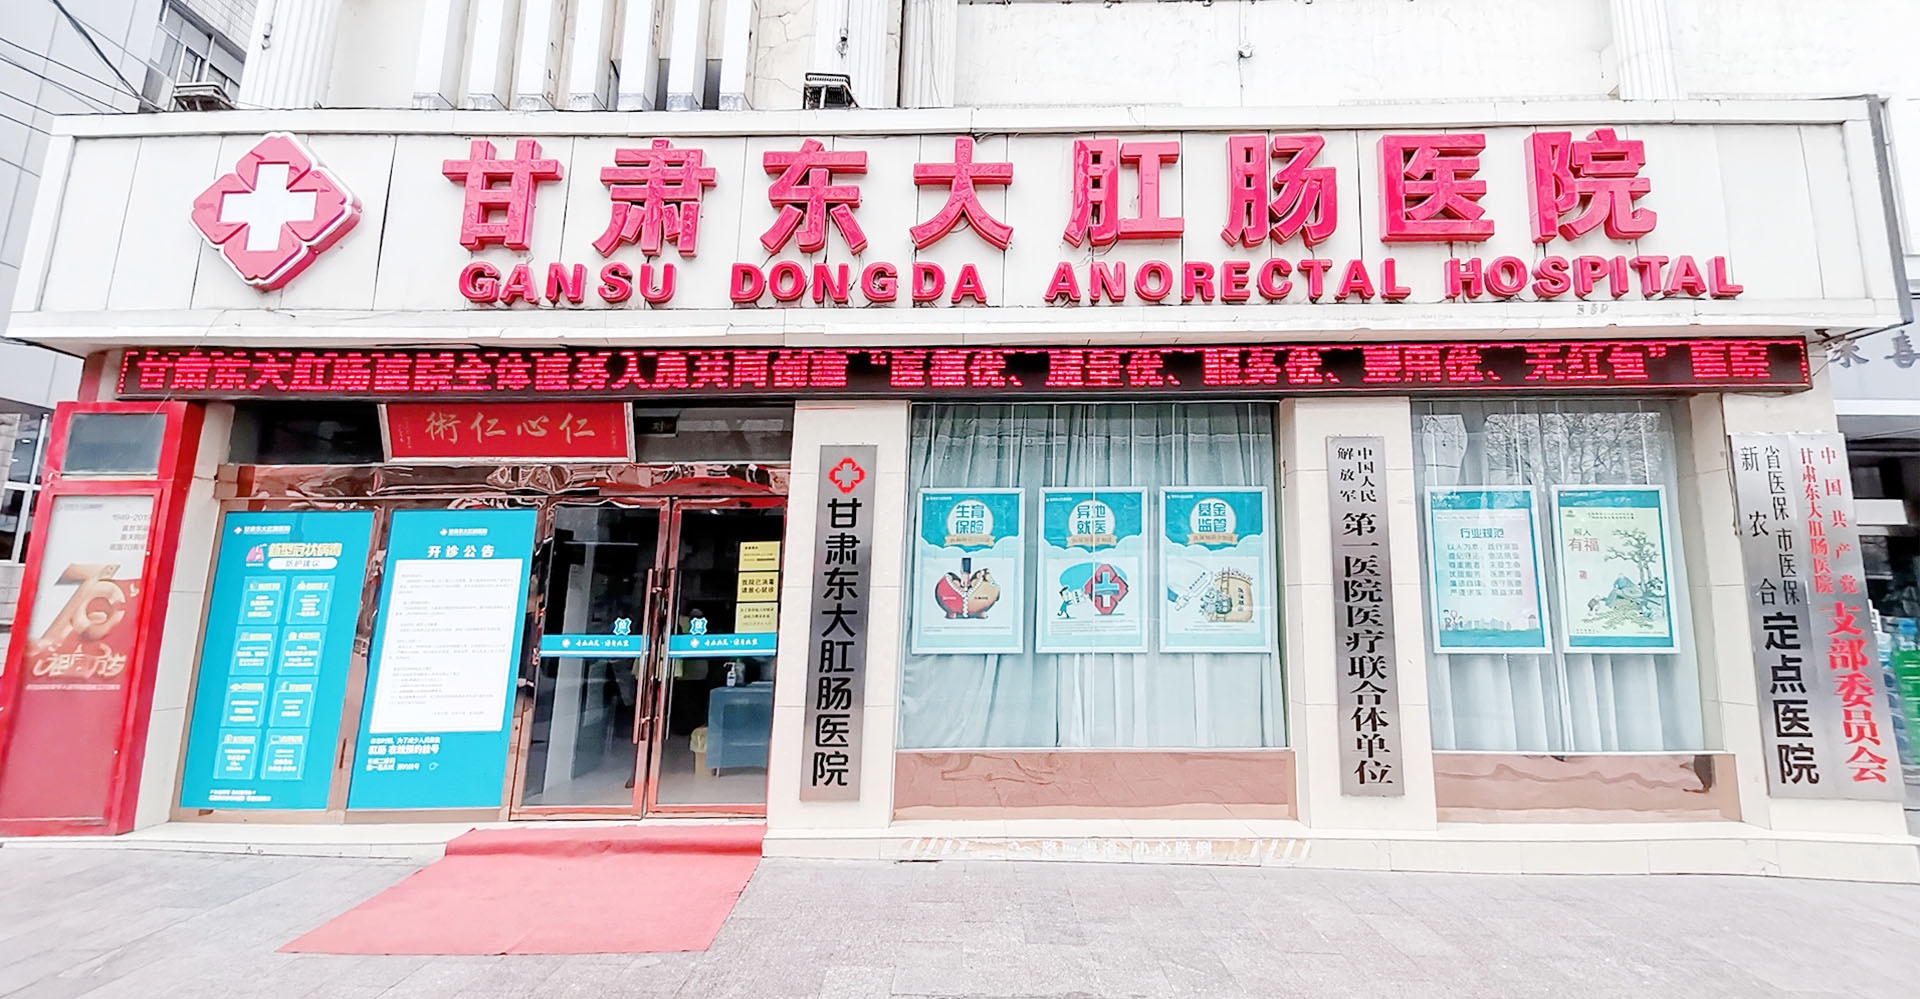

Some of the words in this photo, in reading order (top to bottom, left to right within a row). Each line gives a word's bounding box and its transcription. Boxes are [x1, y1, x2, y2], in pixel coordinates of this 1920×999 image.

[442, 127, 1656, 258] 甘肃东大肛肠医院
[458, 261, 678, 306] GANSU
[730, 260, 987, 306] DONGDA
[1044, 257, 1411, 304] ANORECTAL
[1444, 255, 1744, 300] HOSPITAL
[956, 505, 985, 518] 生育
[1337, 447, 1356, 503] 解放军
[1357, 447, 1377, 503] 中国人民
[1764, 445, 1789, 520] 省医保
[427, 544, 495, 558] 开诊公告
[1460, 527, 1505, 538] 行业规范
[1568, 537, 1600, 552] 有福
[1800, 448, 1835, 593] 甘肃东大肛肠医院
[1821, 447, 1858, 594] 中国共产党
[1776, 528, 1800, 605] 市医保
[812, 497, 862, 787] 甘肃东大肛肠医院
[1341, 513, 1393, 785] 第一医院医疗联合体单位
[1762, 611, 1820, 784] 定点医院
[1818, 601, 1888, 784] 支部委员会
